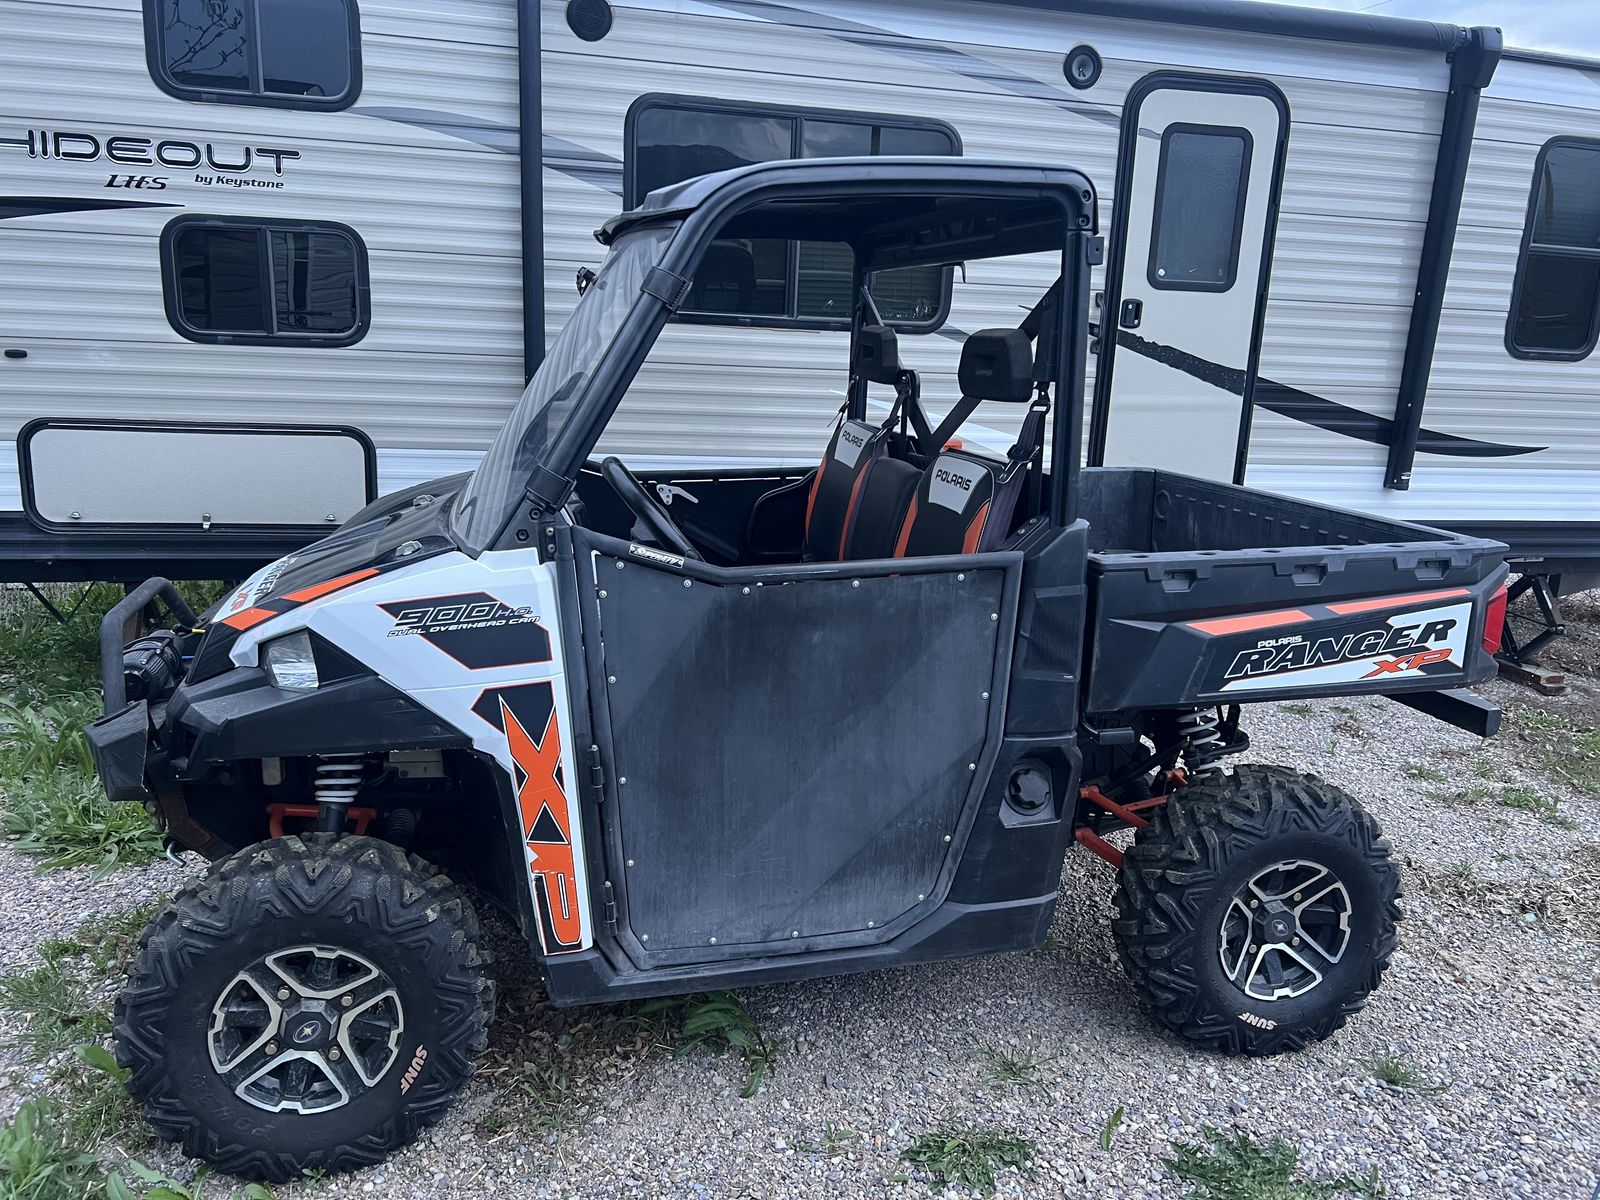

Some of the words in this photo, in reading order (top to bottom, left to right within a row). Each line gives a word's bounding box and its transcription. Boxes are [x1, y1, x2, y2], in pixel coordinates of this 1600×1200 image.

[195, 174, 213, 185] by
[216, 175, 284, 189] Keystone
[842, 430, 864, 448] POLARIS
[935, 469, 972, 491] POLARIS
[394, 601, 501, 627] 900
[387, 628, 426, 637] DUAL
[430, 620, 507, 633] OVERHEAD
[508, 616, 540, 625] CAM
[1224, 619, 1457, 678] RANGER
[1257, 635, 1302, 648] POLARIS
[1359, 648, 1453, 679] XP
[498, 693, 582, 946] XP
[1238, 1012, 1278, 1030] SUNF
[400, 1044, 428, 1096] SUNF
